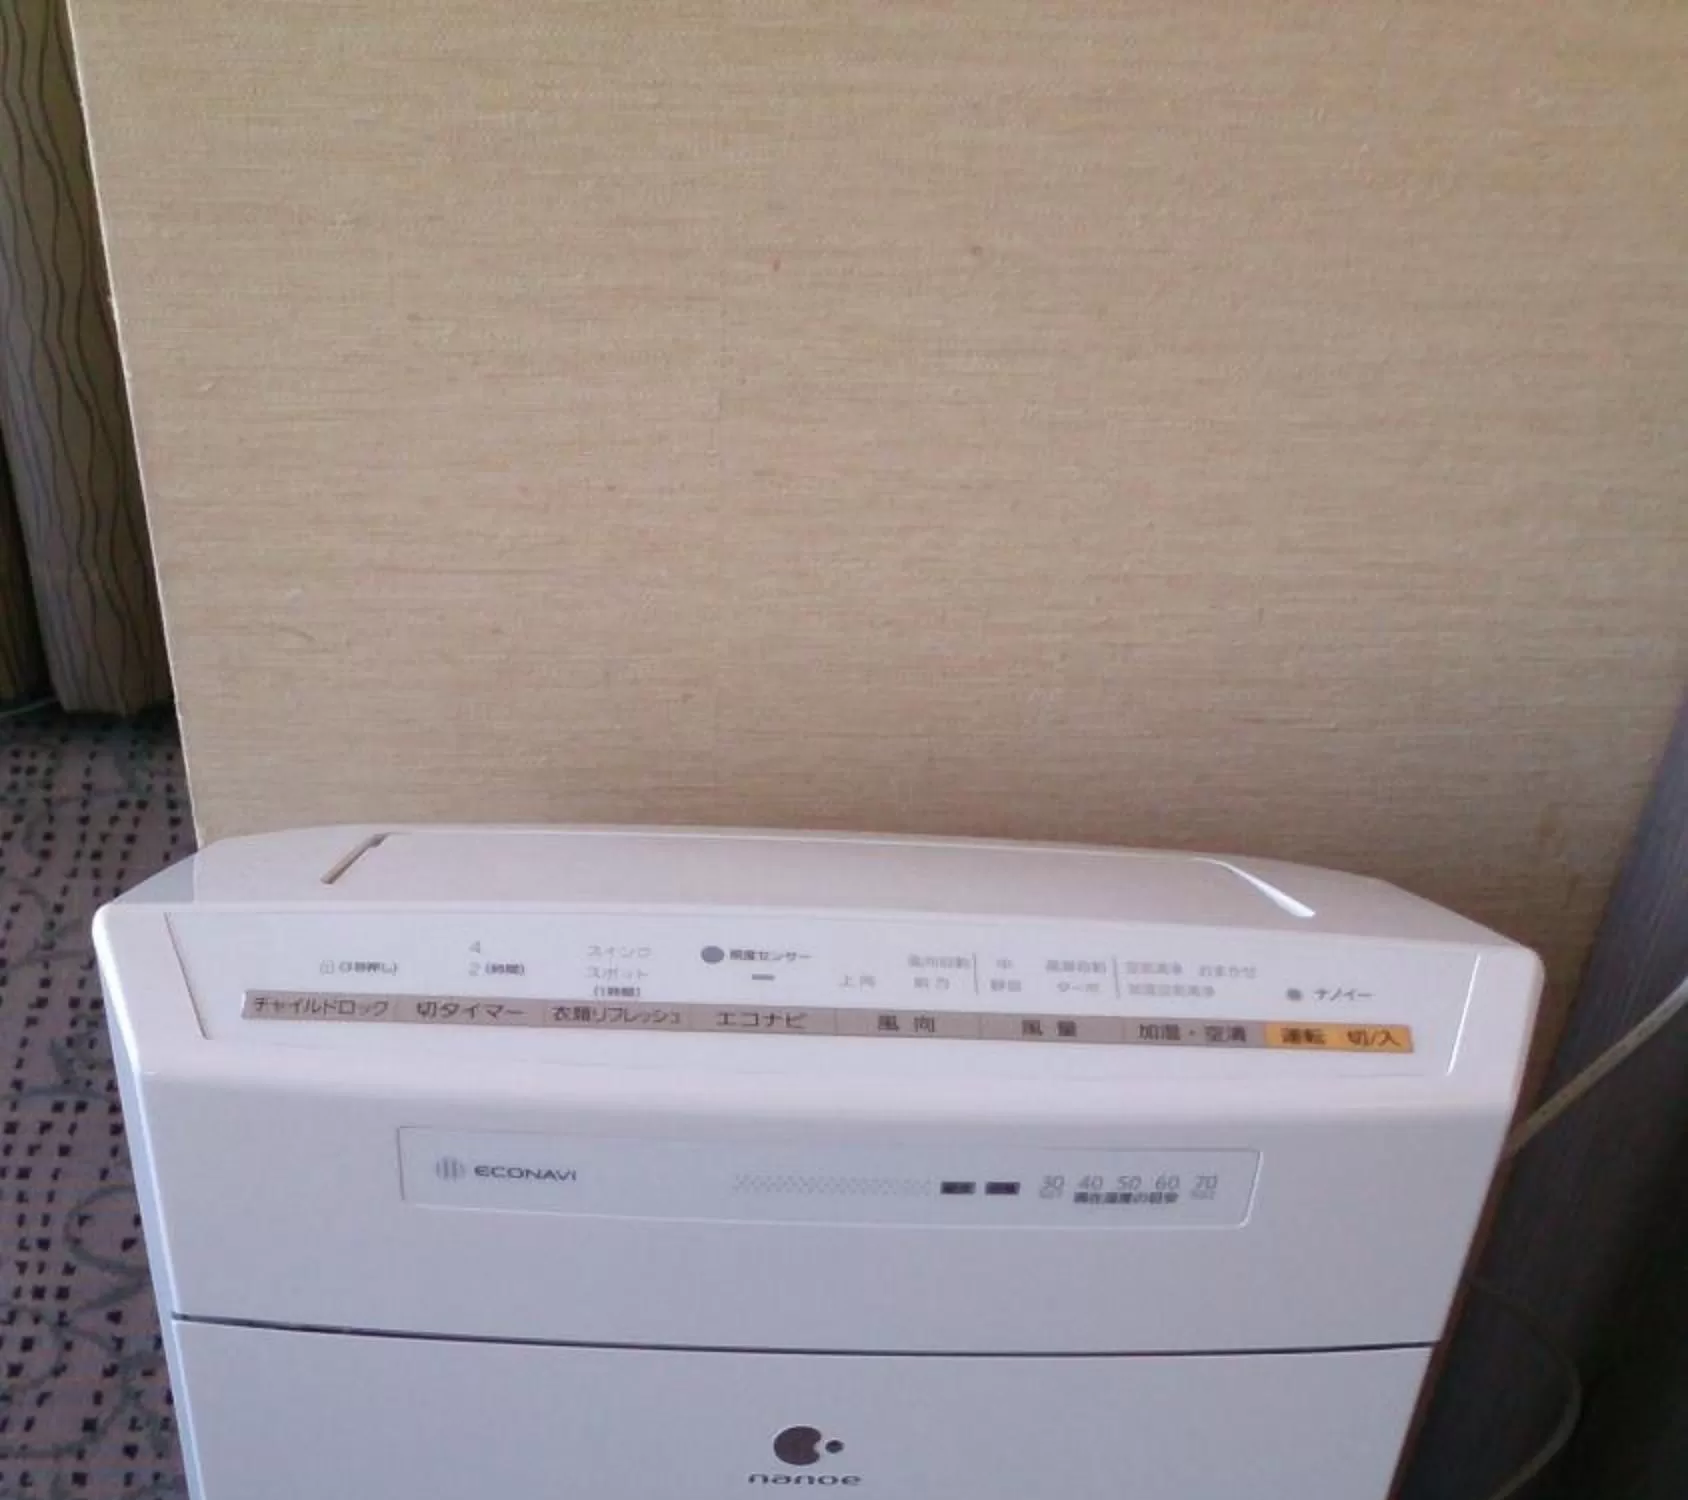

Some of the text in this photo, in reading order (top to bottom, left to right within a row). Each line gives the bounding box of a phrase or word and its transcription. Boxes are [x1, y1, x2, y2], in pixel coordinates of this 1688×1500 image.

[254, 997, 389, 1018] チャイルドロック
[416, 1001, 524, 1019] 切タイマー
[552, 1005, 681, 1025] 衣類リフレッシュ
[716, 1010, 809, 1029] エコナビ
[474, 1165, 577, 1182] ECONAVI
[1077, 1175, 1103, 1190] 40
[1116, 1175, 1143, 1191] 50
[1155, 1175, 1180, 1190] 60
[748, 1473, 861, 1485] nanoe
